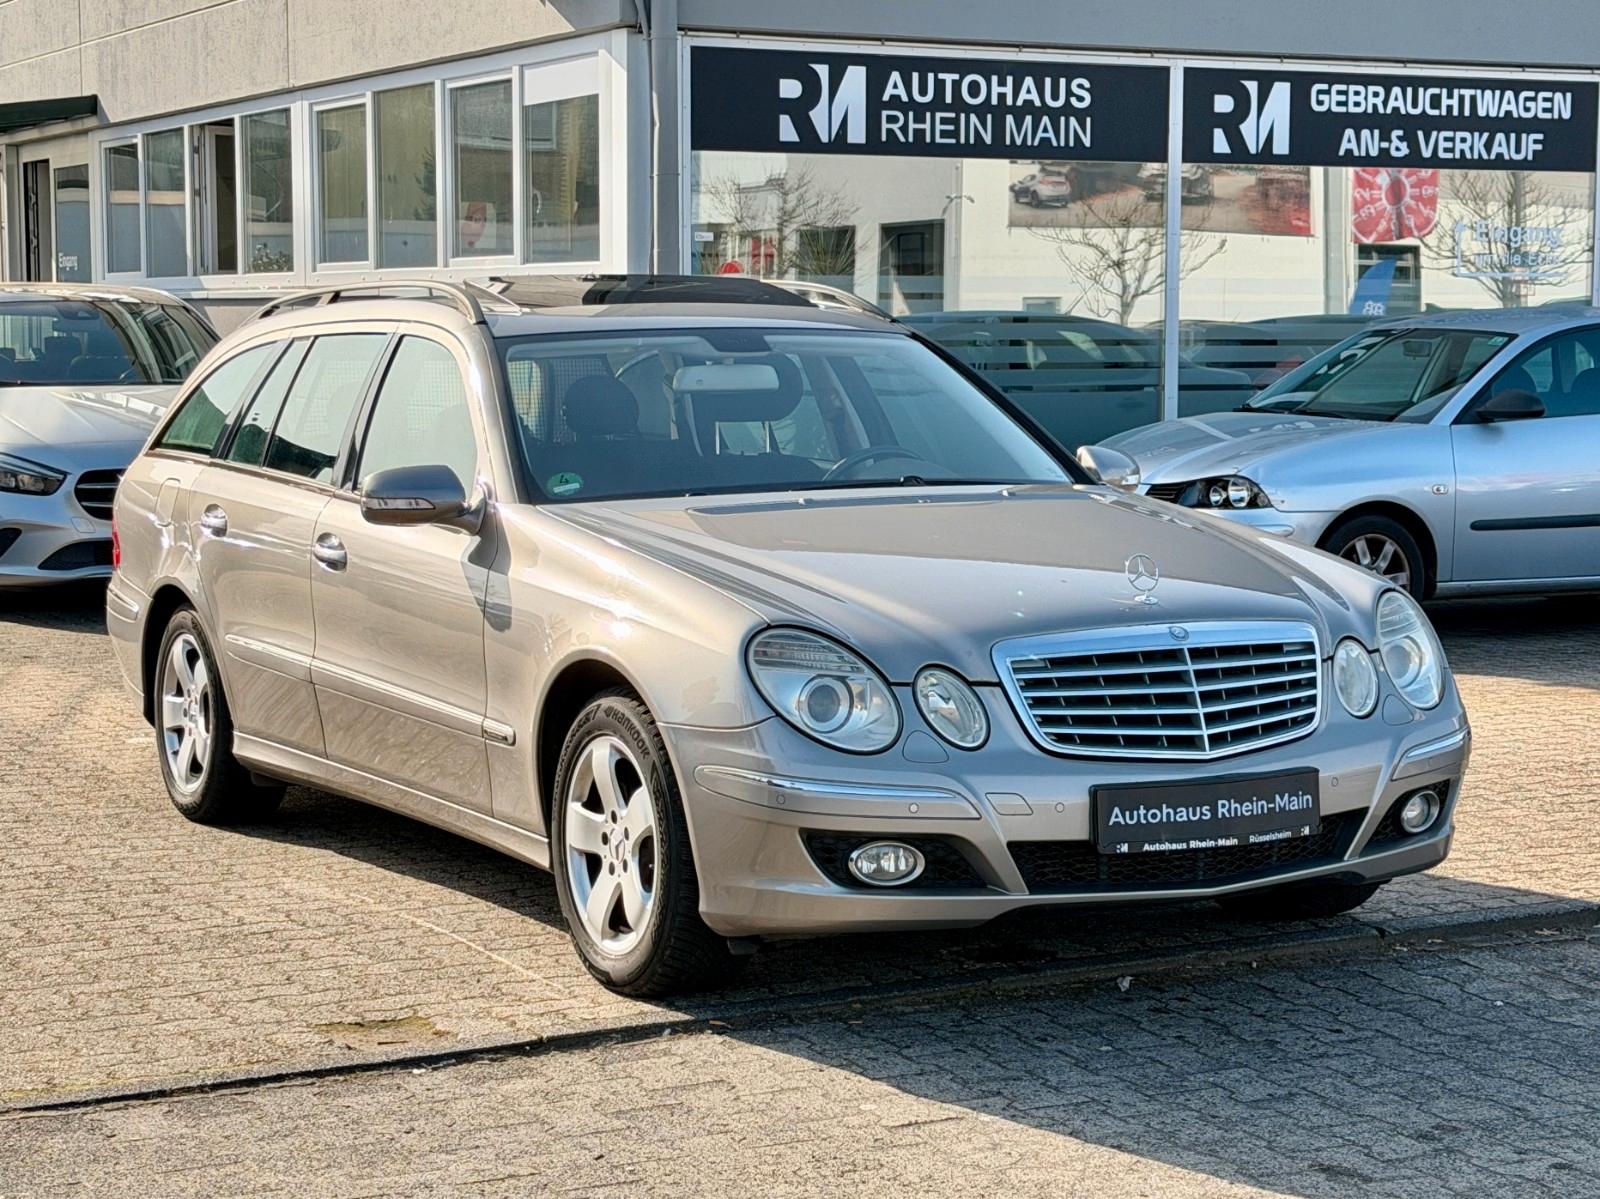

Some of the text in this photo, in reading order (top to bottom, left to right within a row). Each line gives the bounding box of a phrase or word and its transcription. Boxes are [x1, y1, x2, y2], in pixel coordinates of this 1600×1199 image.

[882, 70, 1092, 109] AUTOHAUS
[1310, 82, 1573, 121] GEBRAUCHTWAGEN
[880, 110, 1092, 148] RHEIN MAIN
[1338, 127, 1544, 161] AN-& VERKAUF
[1474, 219, 1562, 248] Eingang
[1108, 790, 1313, 826] Autohaus Rhein-Main
[1142, 828, 1292, 852] Autohaus Rhein-Main Rüsselsheim
